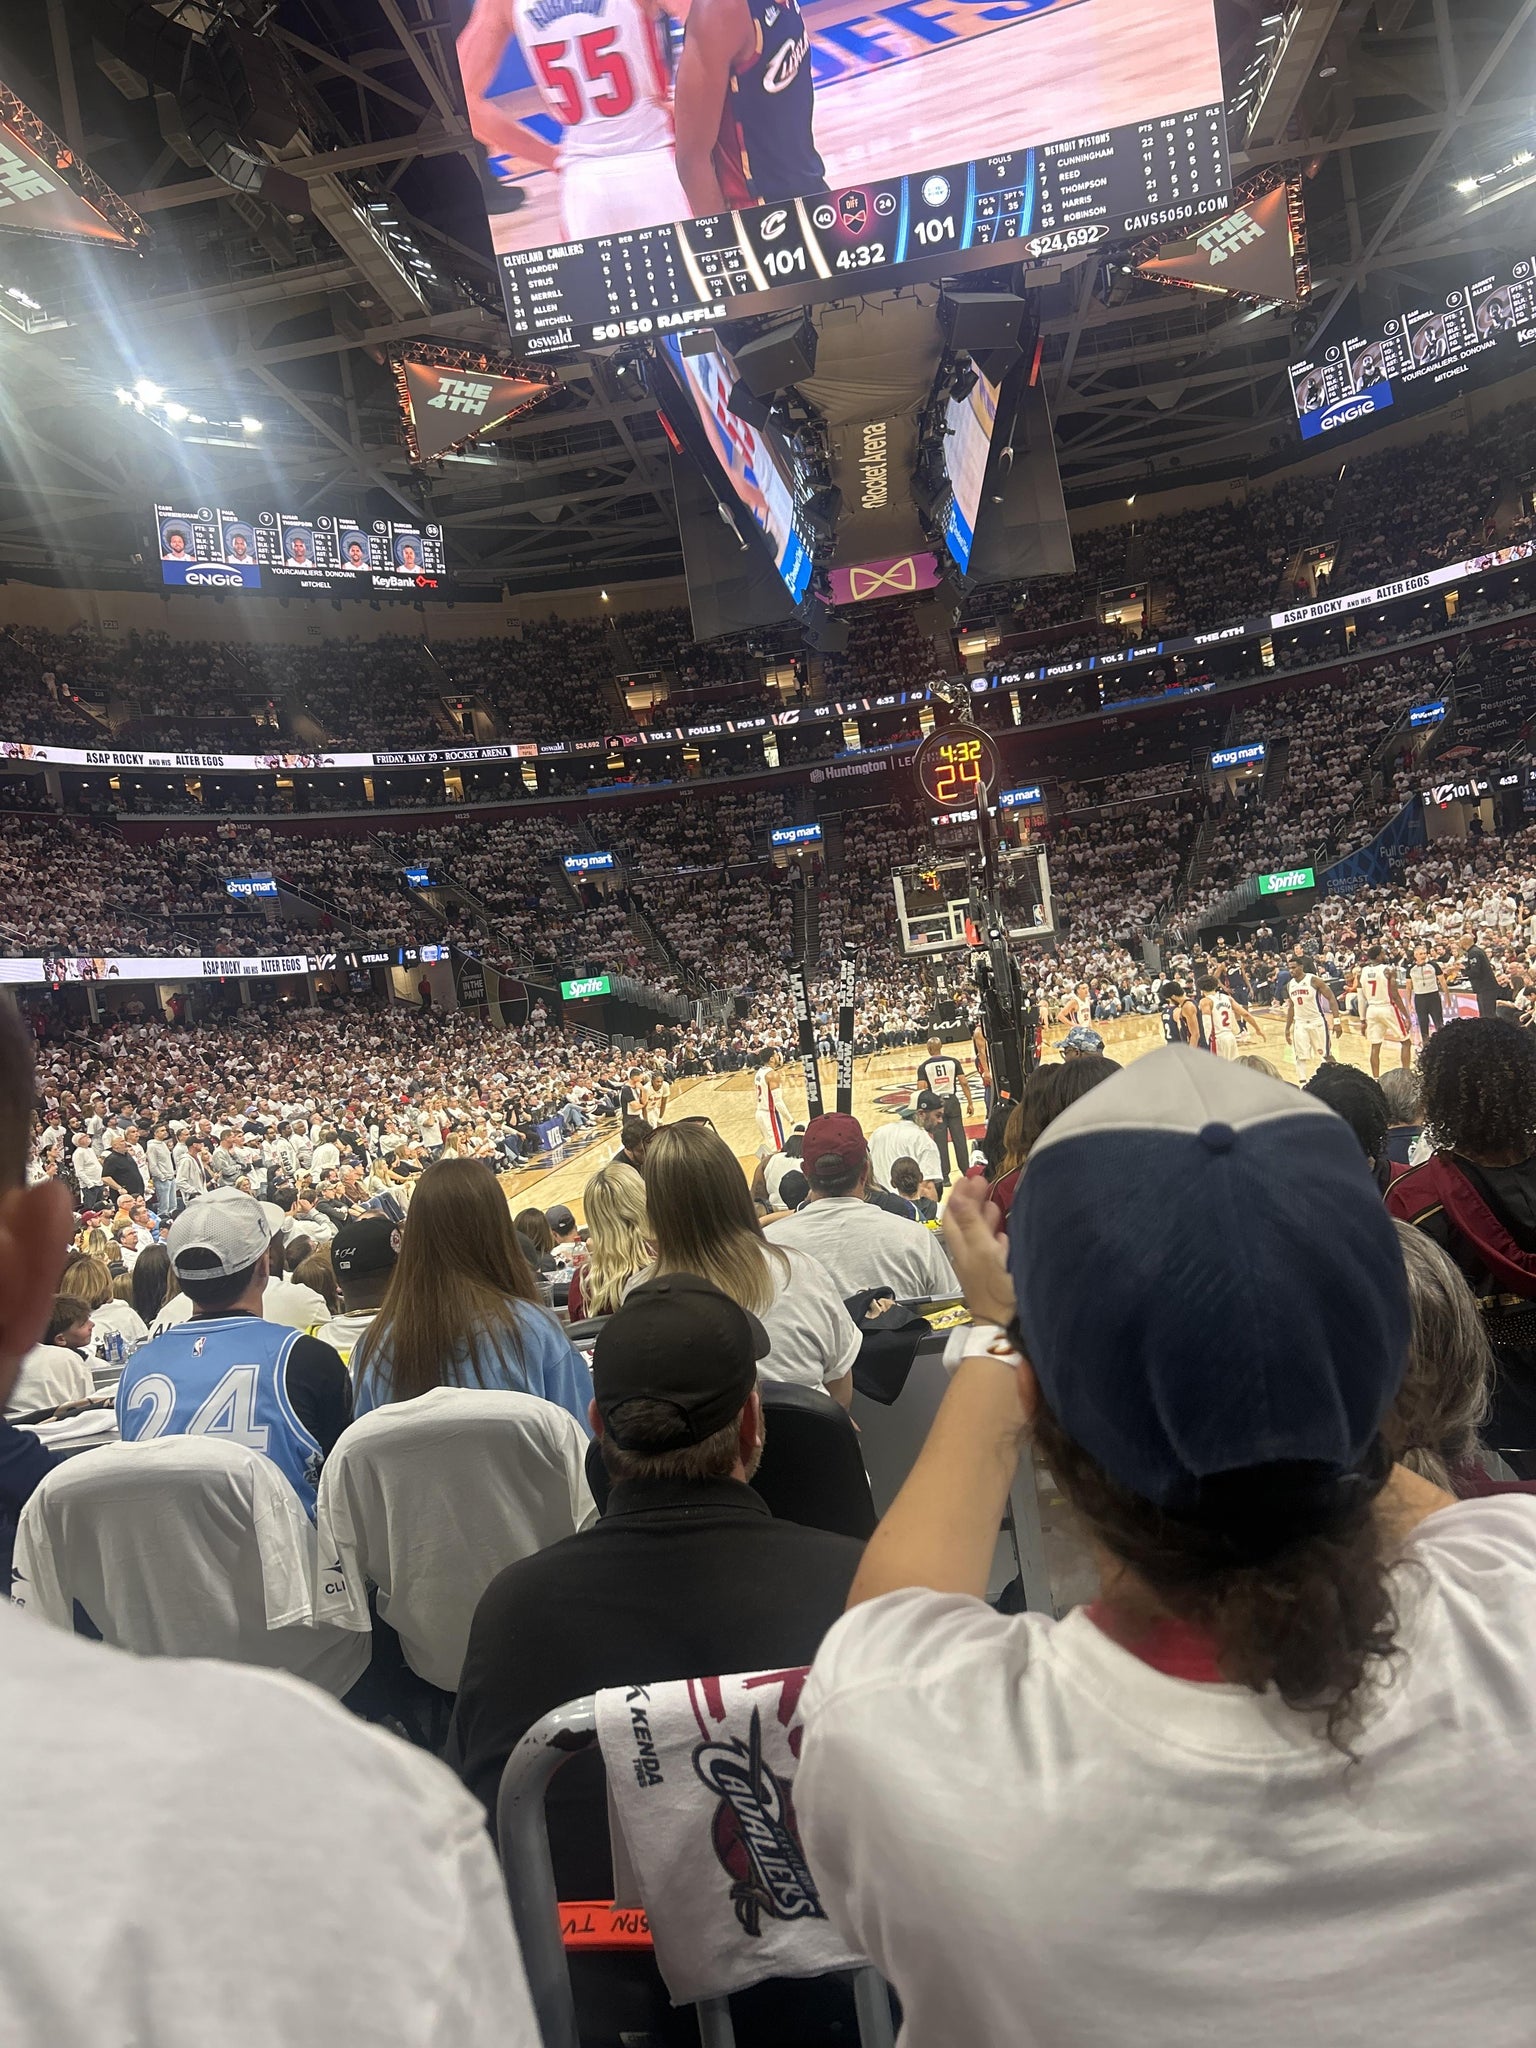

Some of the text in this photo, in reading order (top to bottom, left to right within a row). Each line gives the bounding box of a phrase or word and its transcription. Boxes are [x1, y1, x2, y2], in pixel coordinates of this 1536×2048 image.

[530, 25, 635, 126] 55
[1138, 107, 1220, 133] PTS REB AST FLS
[1044, 132, 1110, 156] DETROIT PISTONS
[988, 155, 1012, 166] FOULS
[1039, 148, 1114, 172] 2 CUNNINGHAM
[997, 166, 1006, 177] 3
[1041, 170, 1080, 186] 7 REED
[1003, 192, 1017, 200] 3PT
[1042, 178, 1108, 200] 9 THOMPSON
[846, 199, 858, 210] DIFF
[879, 199, 892, 210] 24
[983, 202, 1019, 216] 46 35
[1041, 195, 1092, 213] 12 HARRIS
[818, 213, 832, 223] 4Q
[1041, 206, 1106, 228] 55 ROBINSON
[1124, 195, 1228, 232] CAVS5050.COM
[695, 217, 719, 227] FOULS
[914, 216, 955, 244] 101
[977, 218, 1016, 232] TOL CH
[598, 228, 672, 248] PTS REB AST FLS
[705, 228, 714, 238] 3
[982, 234, 988, 242] 2
[1197, 210, 1253, 251] THE
[1029, 226, 1099, 258] $24,692
[1209, 221, 1266, 266] 4TH
[503, 243, 584, 268] CLEVELAND CAVALIERS
[763, 247, 806, 276] 101
[836, 243, 886, 270] 4:32
[509, 263, 558, 278] 1 HARDEN
[728, 260, 740, 269] 38
[511, 277, 554, 291] 2 STRUS
[710, 274, 746, 287] TOL CH
[513, 289, 564, 305] 5 MERRILL
[715, 288, 722, 297] 2
[514, 304, 558, 318] 31 ALLEN
[657, 304, 727, 329] RAFFLE
[515, 314, 573, 332] 45 MITCHELL
[528, 327, 573, 349] oswald
[1434, 364, 1469, 382] MITCHELL
[437, 377, 494, 400] THE
[427, 394, 488, 416] 4TH
[858, 422, 888, 502] Rocket Arena
[300, 580, 332, 588] MITCHELL
[372, 575, 416, 588] KeyBank
[1311, 600, 1342, 618] ROCKY
[1347, 600, 1360, 608] AND
[1376, 583, 1404, 600] ALTER
[1405, 575, 1430, 591] EGOS
[1194, 626, 1244, 644] THE 4TH
[1100, 655, 1116, 664] TOL
[1047, 664, 1074, 676] FOULS
[1001, 674, 1020, 684] FG%
[876, 696, 894, 705] 4:32
[814, 706, 829, 716] 101
[650, 732, 666, 740] TOL
[688, 726, 716, 736] FOULS
[541, 742, 564, 752] oswald
[940, 740, 981, 763] 4:32
[1212, 744, 1265, 765] drug mart
[113, 754, 144, 765] ROCKY
[175, 755, 200, 766] ALTER
[202, 756, 224, 766] EGOS
[376, 754, 406, 764] FRIDAY,
[407, 753, 427, 762] MAY
[428, 752, 438, 762] 29
[445, 750, 478, 760] ROCKET
[481, 748, 508, 758] ARENA
[825, 760, 887, 779] Huntington
[935, 761, 980, 800] 24
[1499, 775, 1518, 786] 4:32
[1015, 787, 1040, 801] mart
[1452, 785, 1470, 798] 101
[949, 806, 997, 823] TISST
[771, 825, 820, 844] drug mart
[1380, 845, 1396, 858] Full
[565, 852, 612, 871] drug mart
[227, 880, 276, 896] drug mart
[1267, 871, 1307, 892] Sprite
[1326, 874, 1368, 888] COMCAST
[361, 953, 388, 962] STEALS
[405, 950, 416, 960] 12
[221, 960, 241, 974] ROCKY
[261, 959, 281, 972] ALTER
[283, 958, 300, 970] EGOS
[462, 979, 483, 989] IN THE
[569, 979, 602, 998] Sprite
[1368, 981, 1377, 996] 7
[464, 988, 484, 1000] PAINT
[1221, 1011, 1230, 1027] 2
[934, 1064, 948, 1076] 61
[127, 1364, 269, 1453] 24
[629, 1707, 664, 1787] KENDA
[632, 1757, 648, 1788] TIRES
[691, 1736, 828, 1920] CAVALIERS
[563, 1913, 650, 1934] SPN TV
